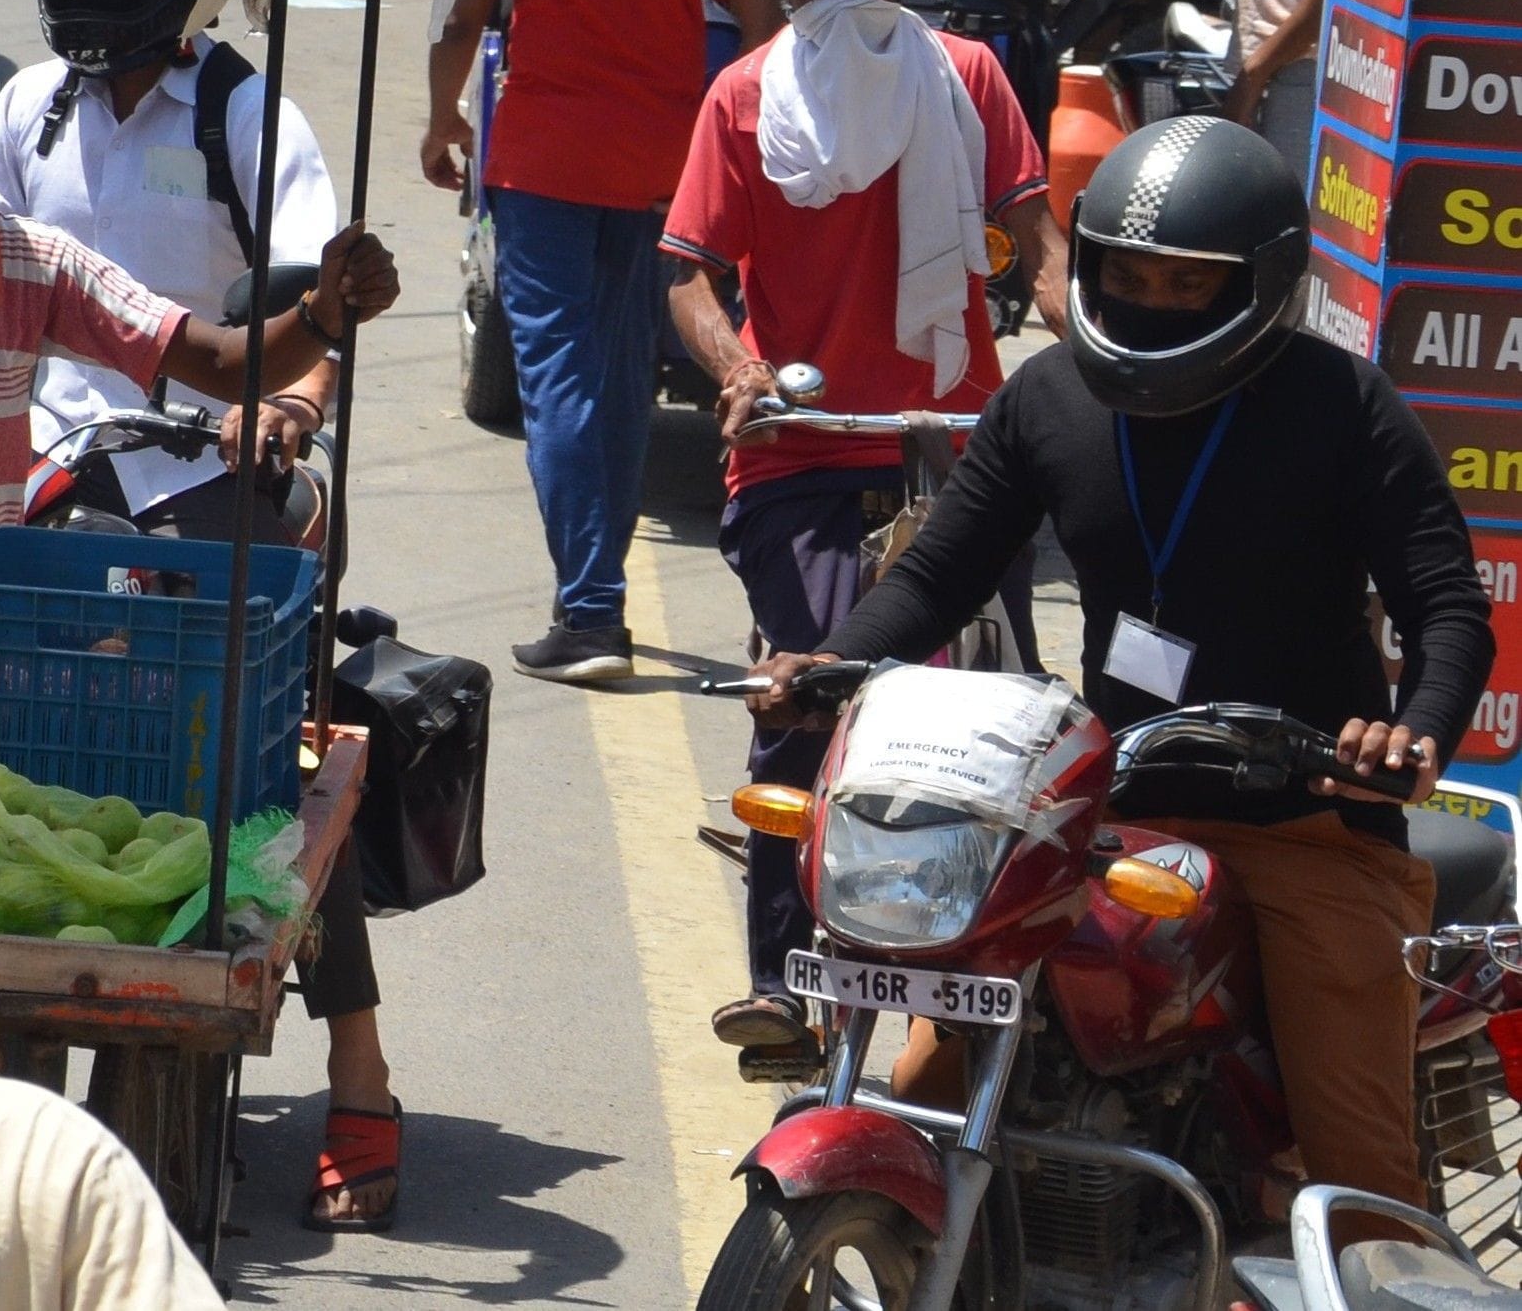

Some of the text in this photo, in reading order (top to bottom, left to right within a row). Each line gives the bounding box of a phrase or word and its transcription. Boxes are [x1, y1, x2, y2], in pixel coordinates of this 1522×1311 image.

[1327, 24, 1397, 124] Downloading
[1319, 155, 1379, 237] Software
[1413, 310, 1482, 370] All
[869, 759, 988, 787] LABORATORY SERVICES
[887, 741, 970, 760] EMERGENCY
[793, 958, 1014, 1018] HR 16R 5199
